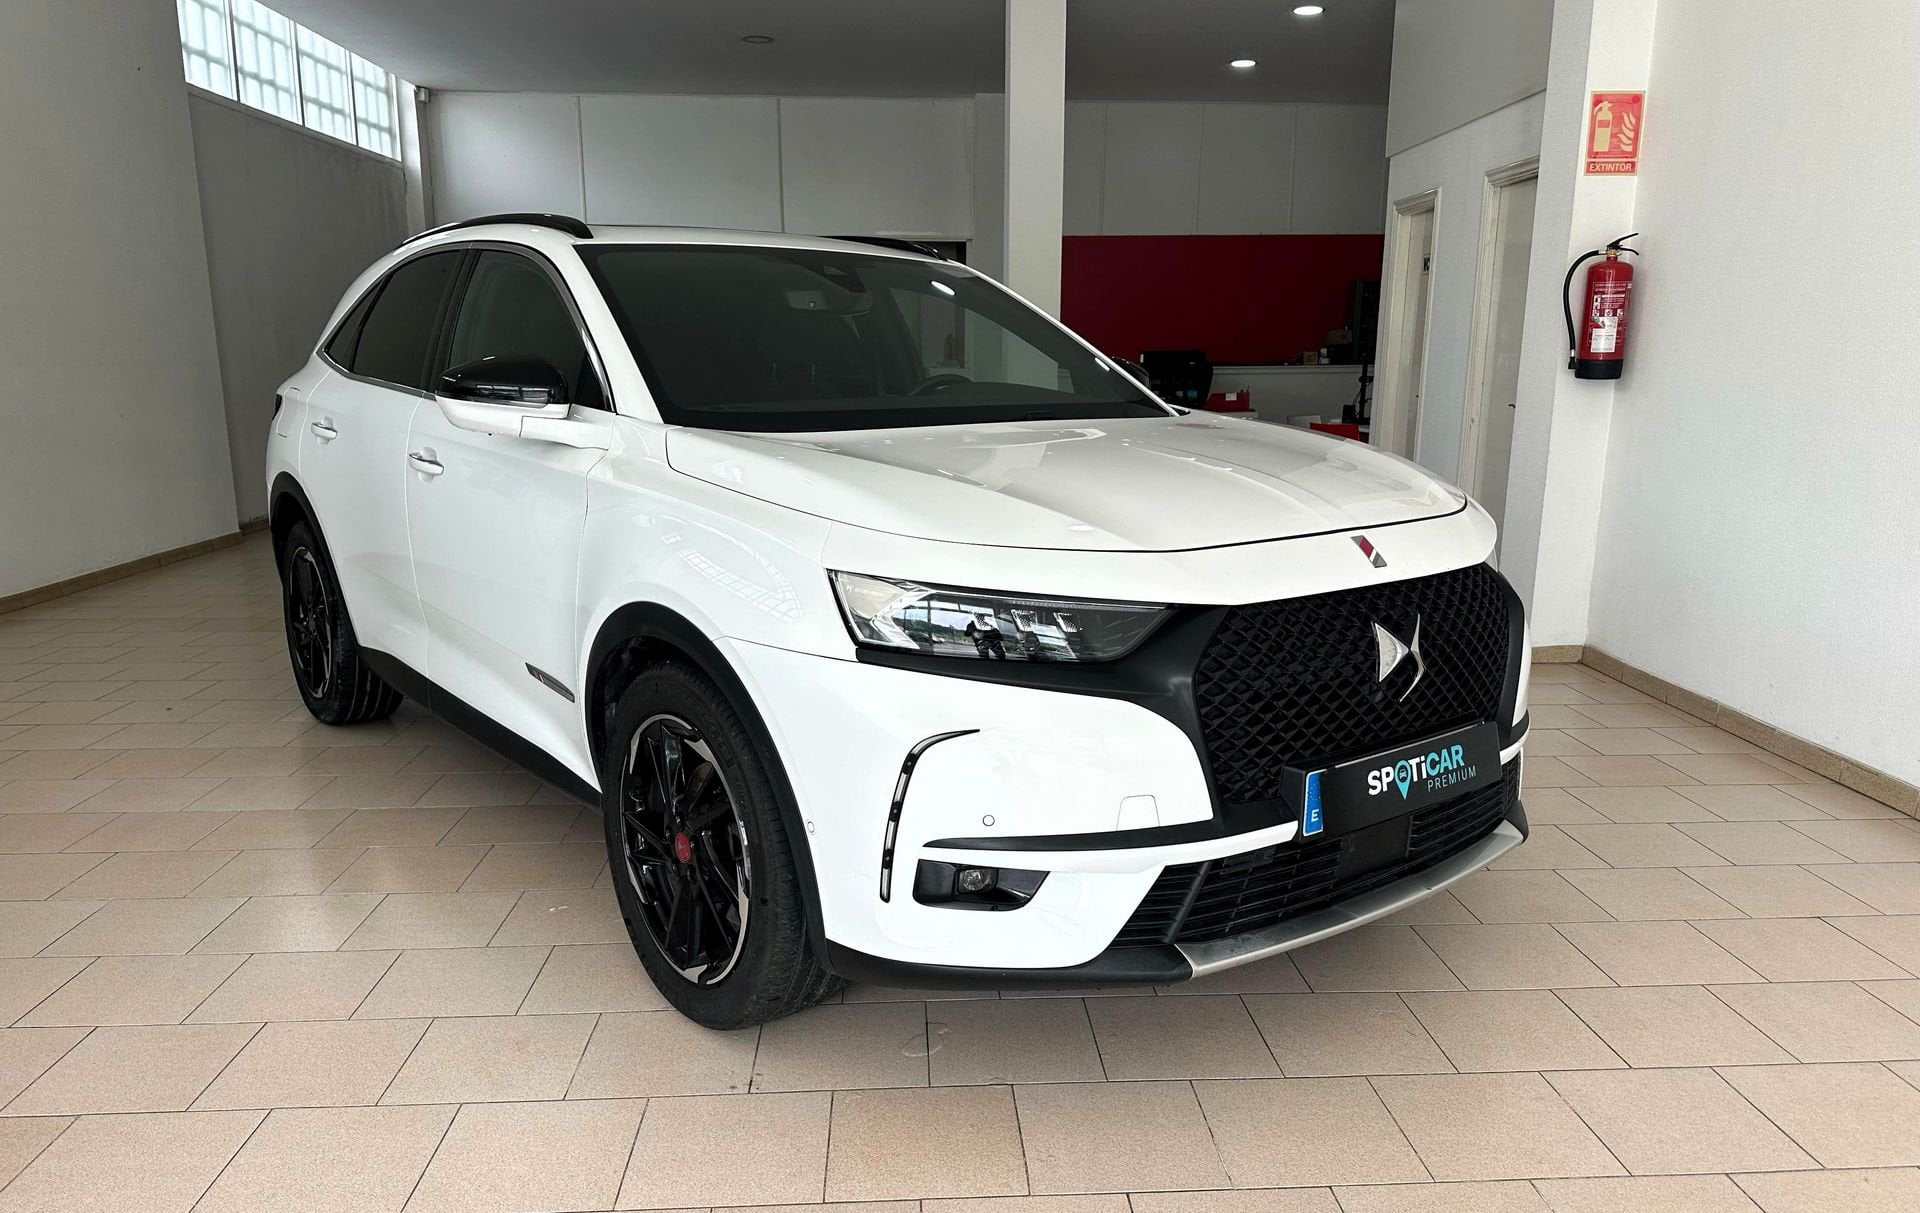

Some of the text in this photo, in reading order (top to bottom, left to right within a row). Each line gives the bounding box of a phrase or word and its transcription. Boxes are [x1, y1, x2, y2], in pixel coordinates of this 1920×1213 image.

[1589, 163, 1632, 172] EXTINTOR
[1427, 765, 1477, 793] PREMIUM
[1311, 808, 1320, 822] E
